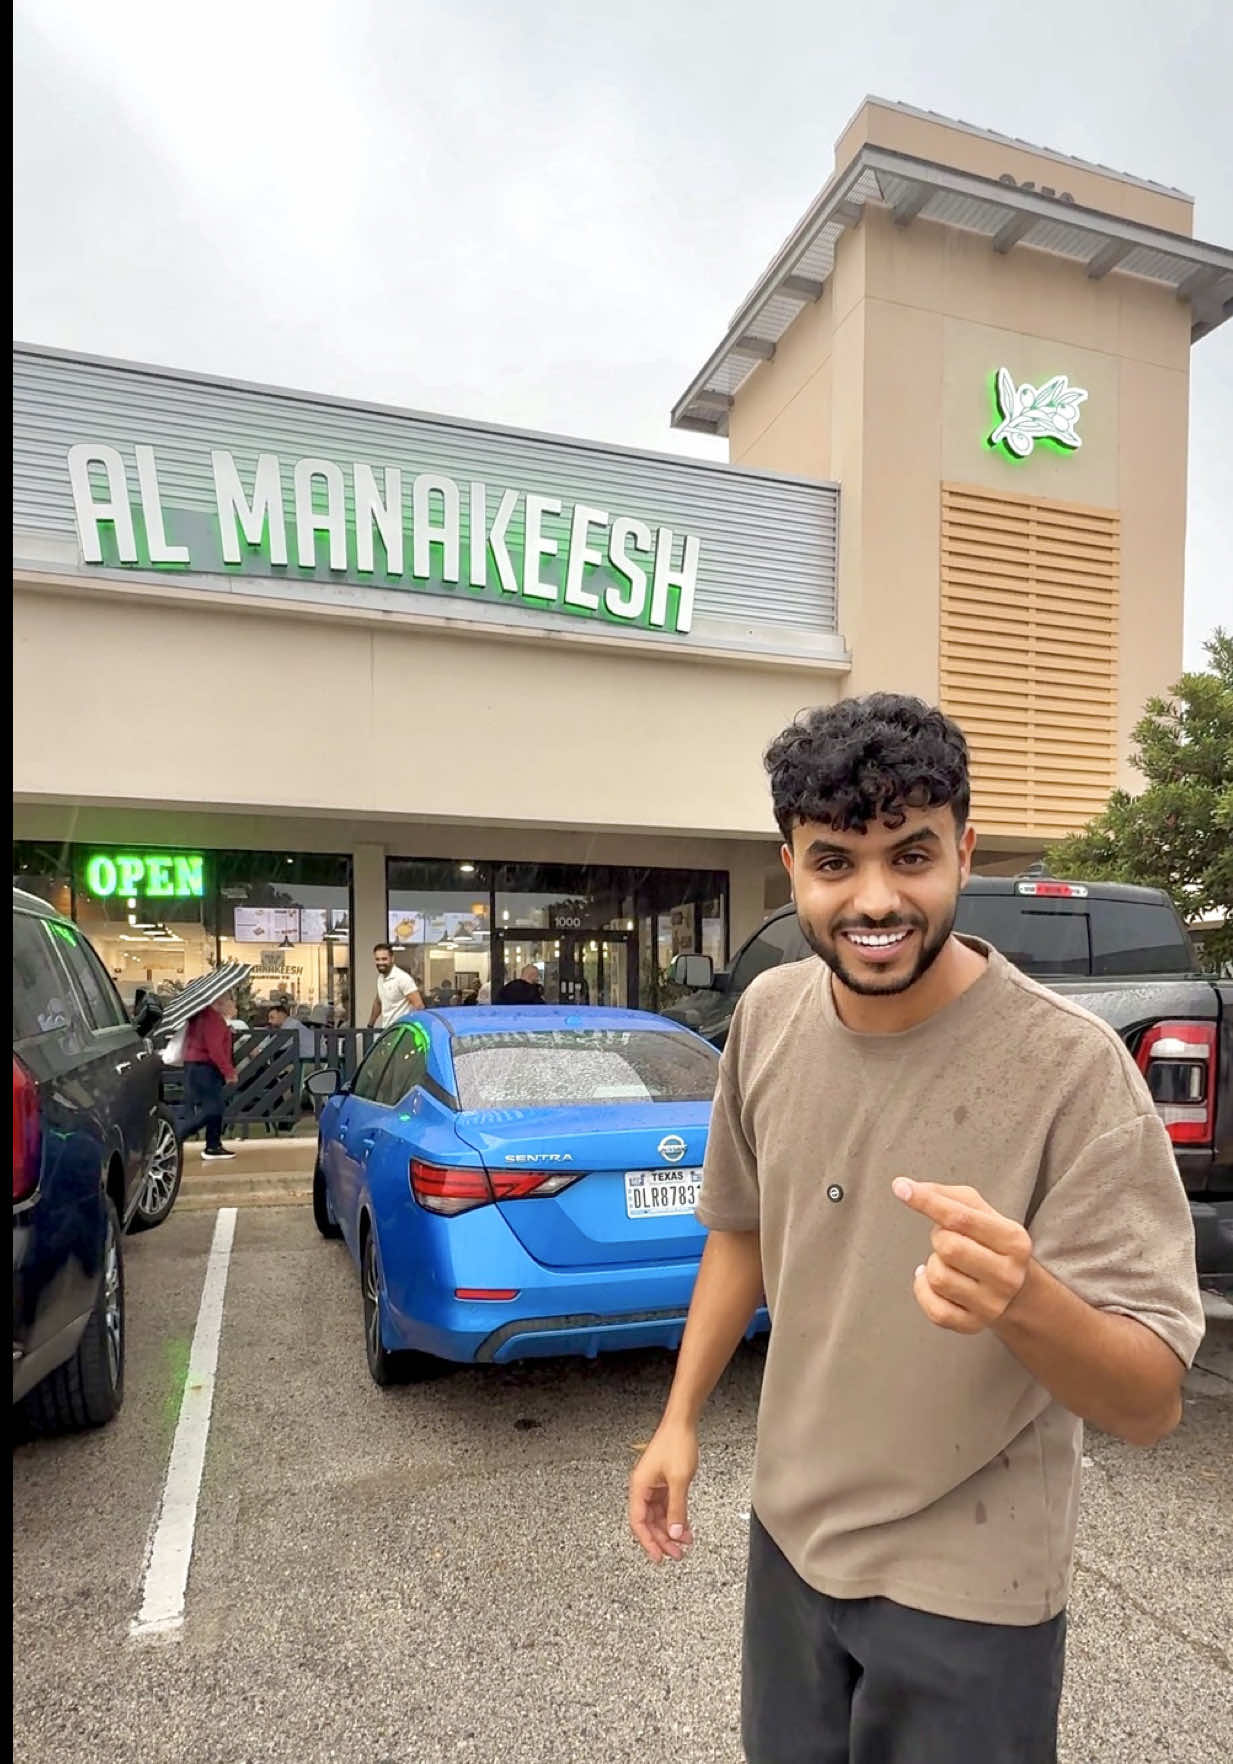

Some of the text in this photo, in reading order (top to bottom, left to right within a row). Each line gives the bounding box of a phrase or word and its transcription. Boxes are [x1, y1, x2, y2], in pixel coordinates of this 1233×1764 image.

[67, 444, 700, 633] AL MANAKEESH
[88, 855, 203, 896] OPEN
[555, 917, 581, 927] 1000
[504, 1154, 574, 1162] SENTRA
[651, 1171, 684, 1182] TEXAS
[633, 1185, 701, 1209] DLR8783
